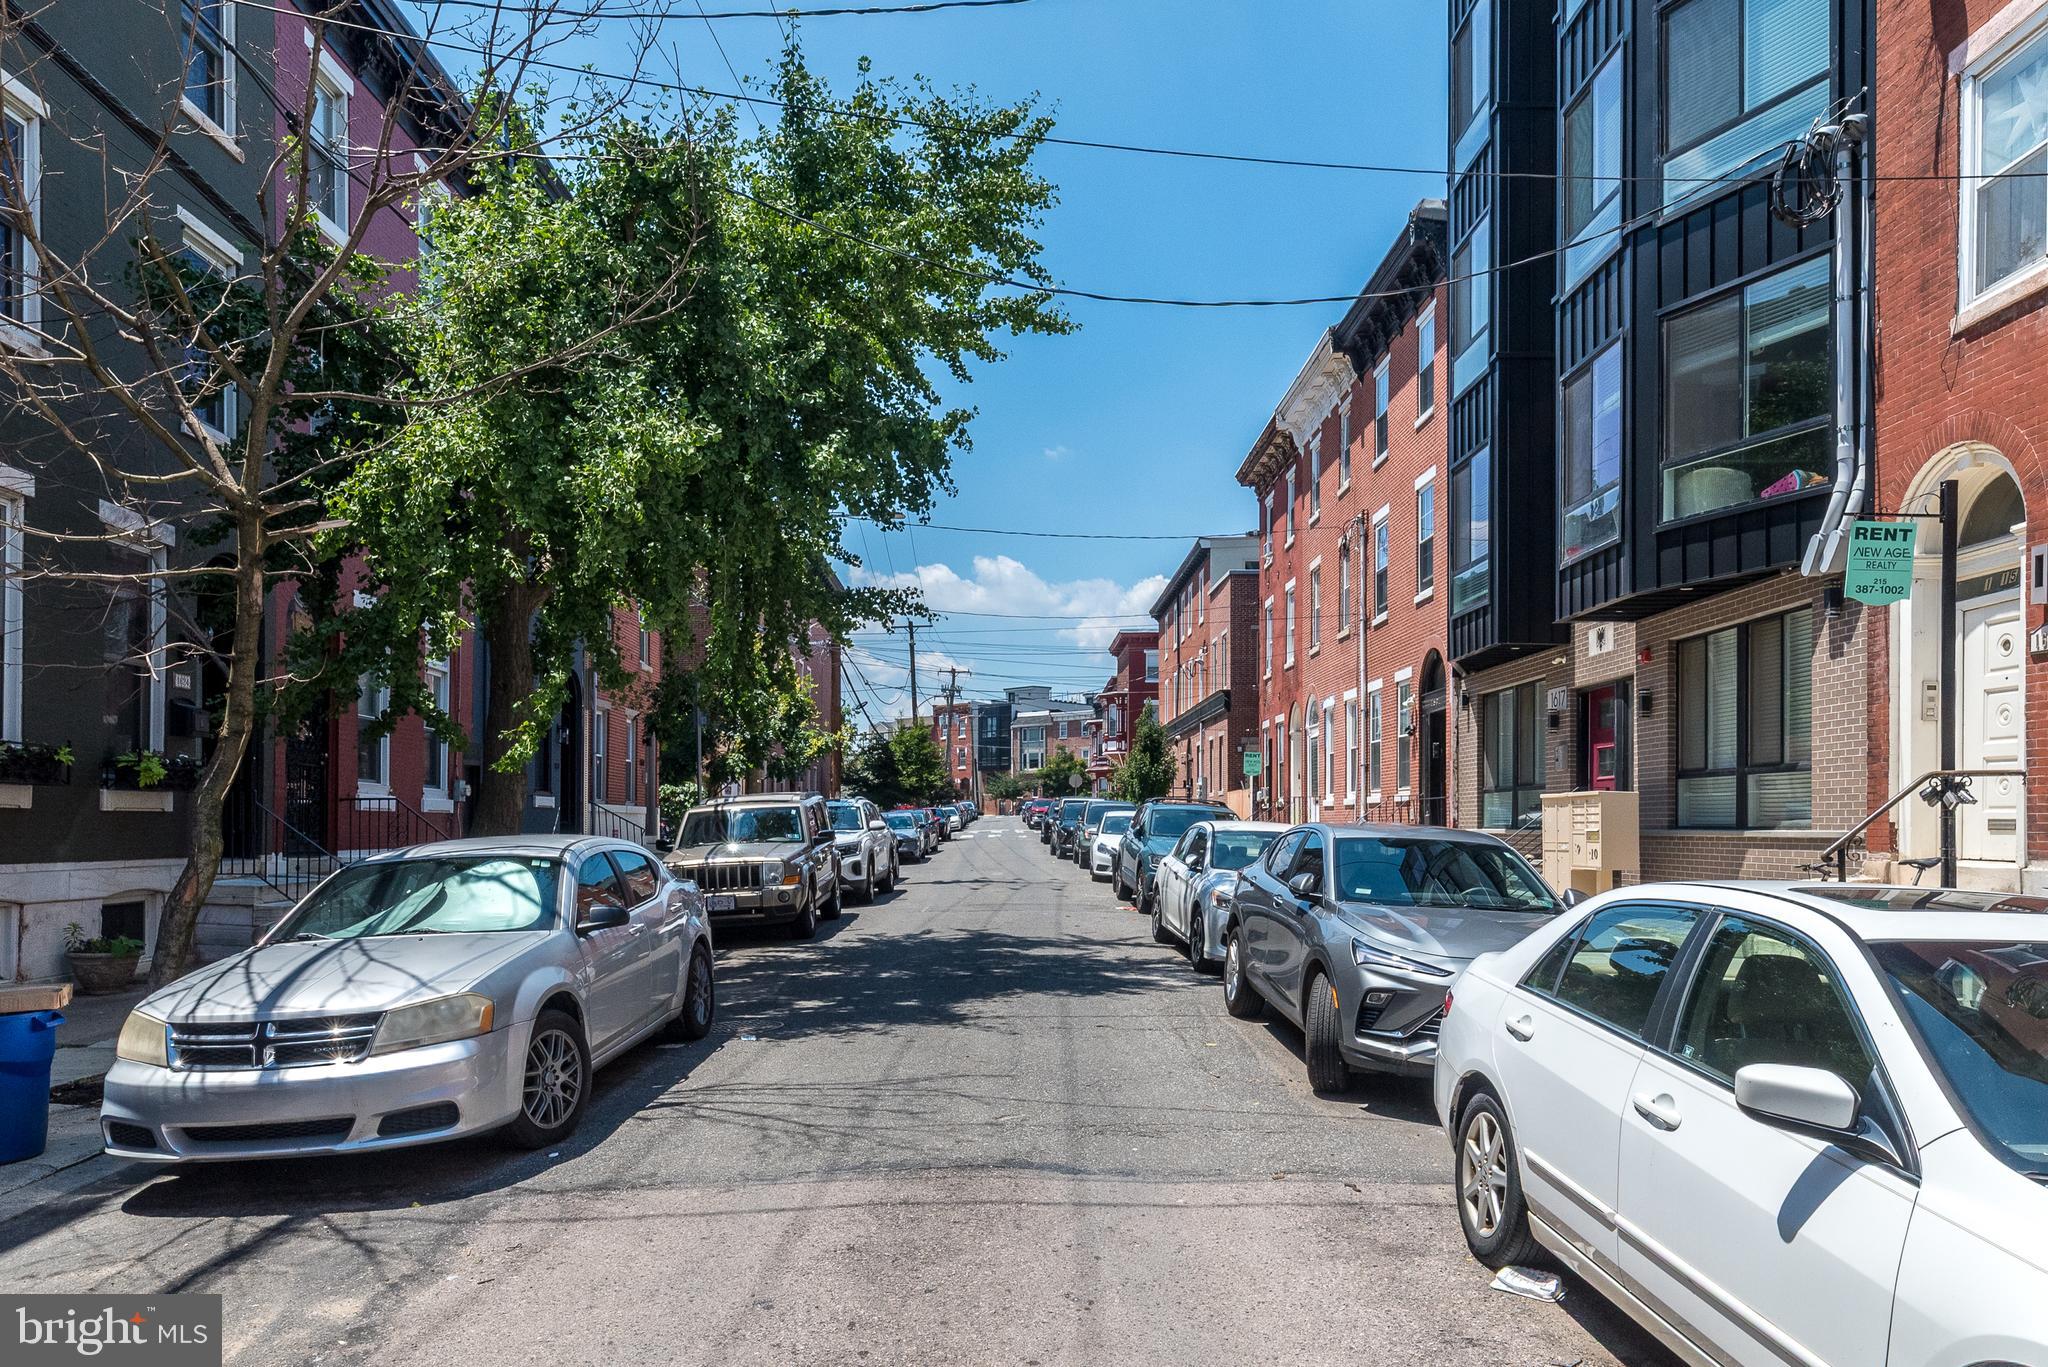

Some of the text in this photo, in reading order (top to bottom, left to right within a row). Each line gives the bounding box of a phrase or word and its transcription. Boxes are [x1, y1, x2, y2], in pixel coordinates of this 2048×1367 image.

[1854, 526, 1913, 542] RENT
[1853, 546, 1912, 558] NEW AGE
[1865, 560, 1897, 570] REALTY
[1855, 585, 1904, 595] 387-1002
[1551, 689, 1566, 708] 1617
[1591, 848, 1599, 860] 10
